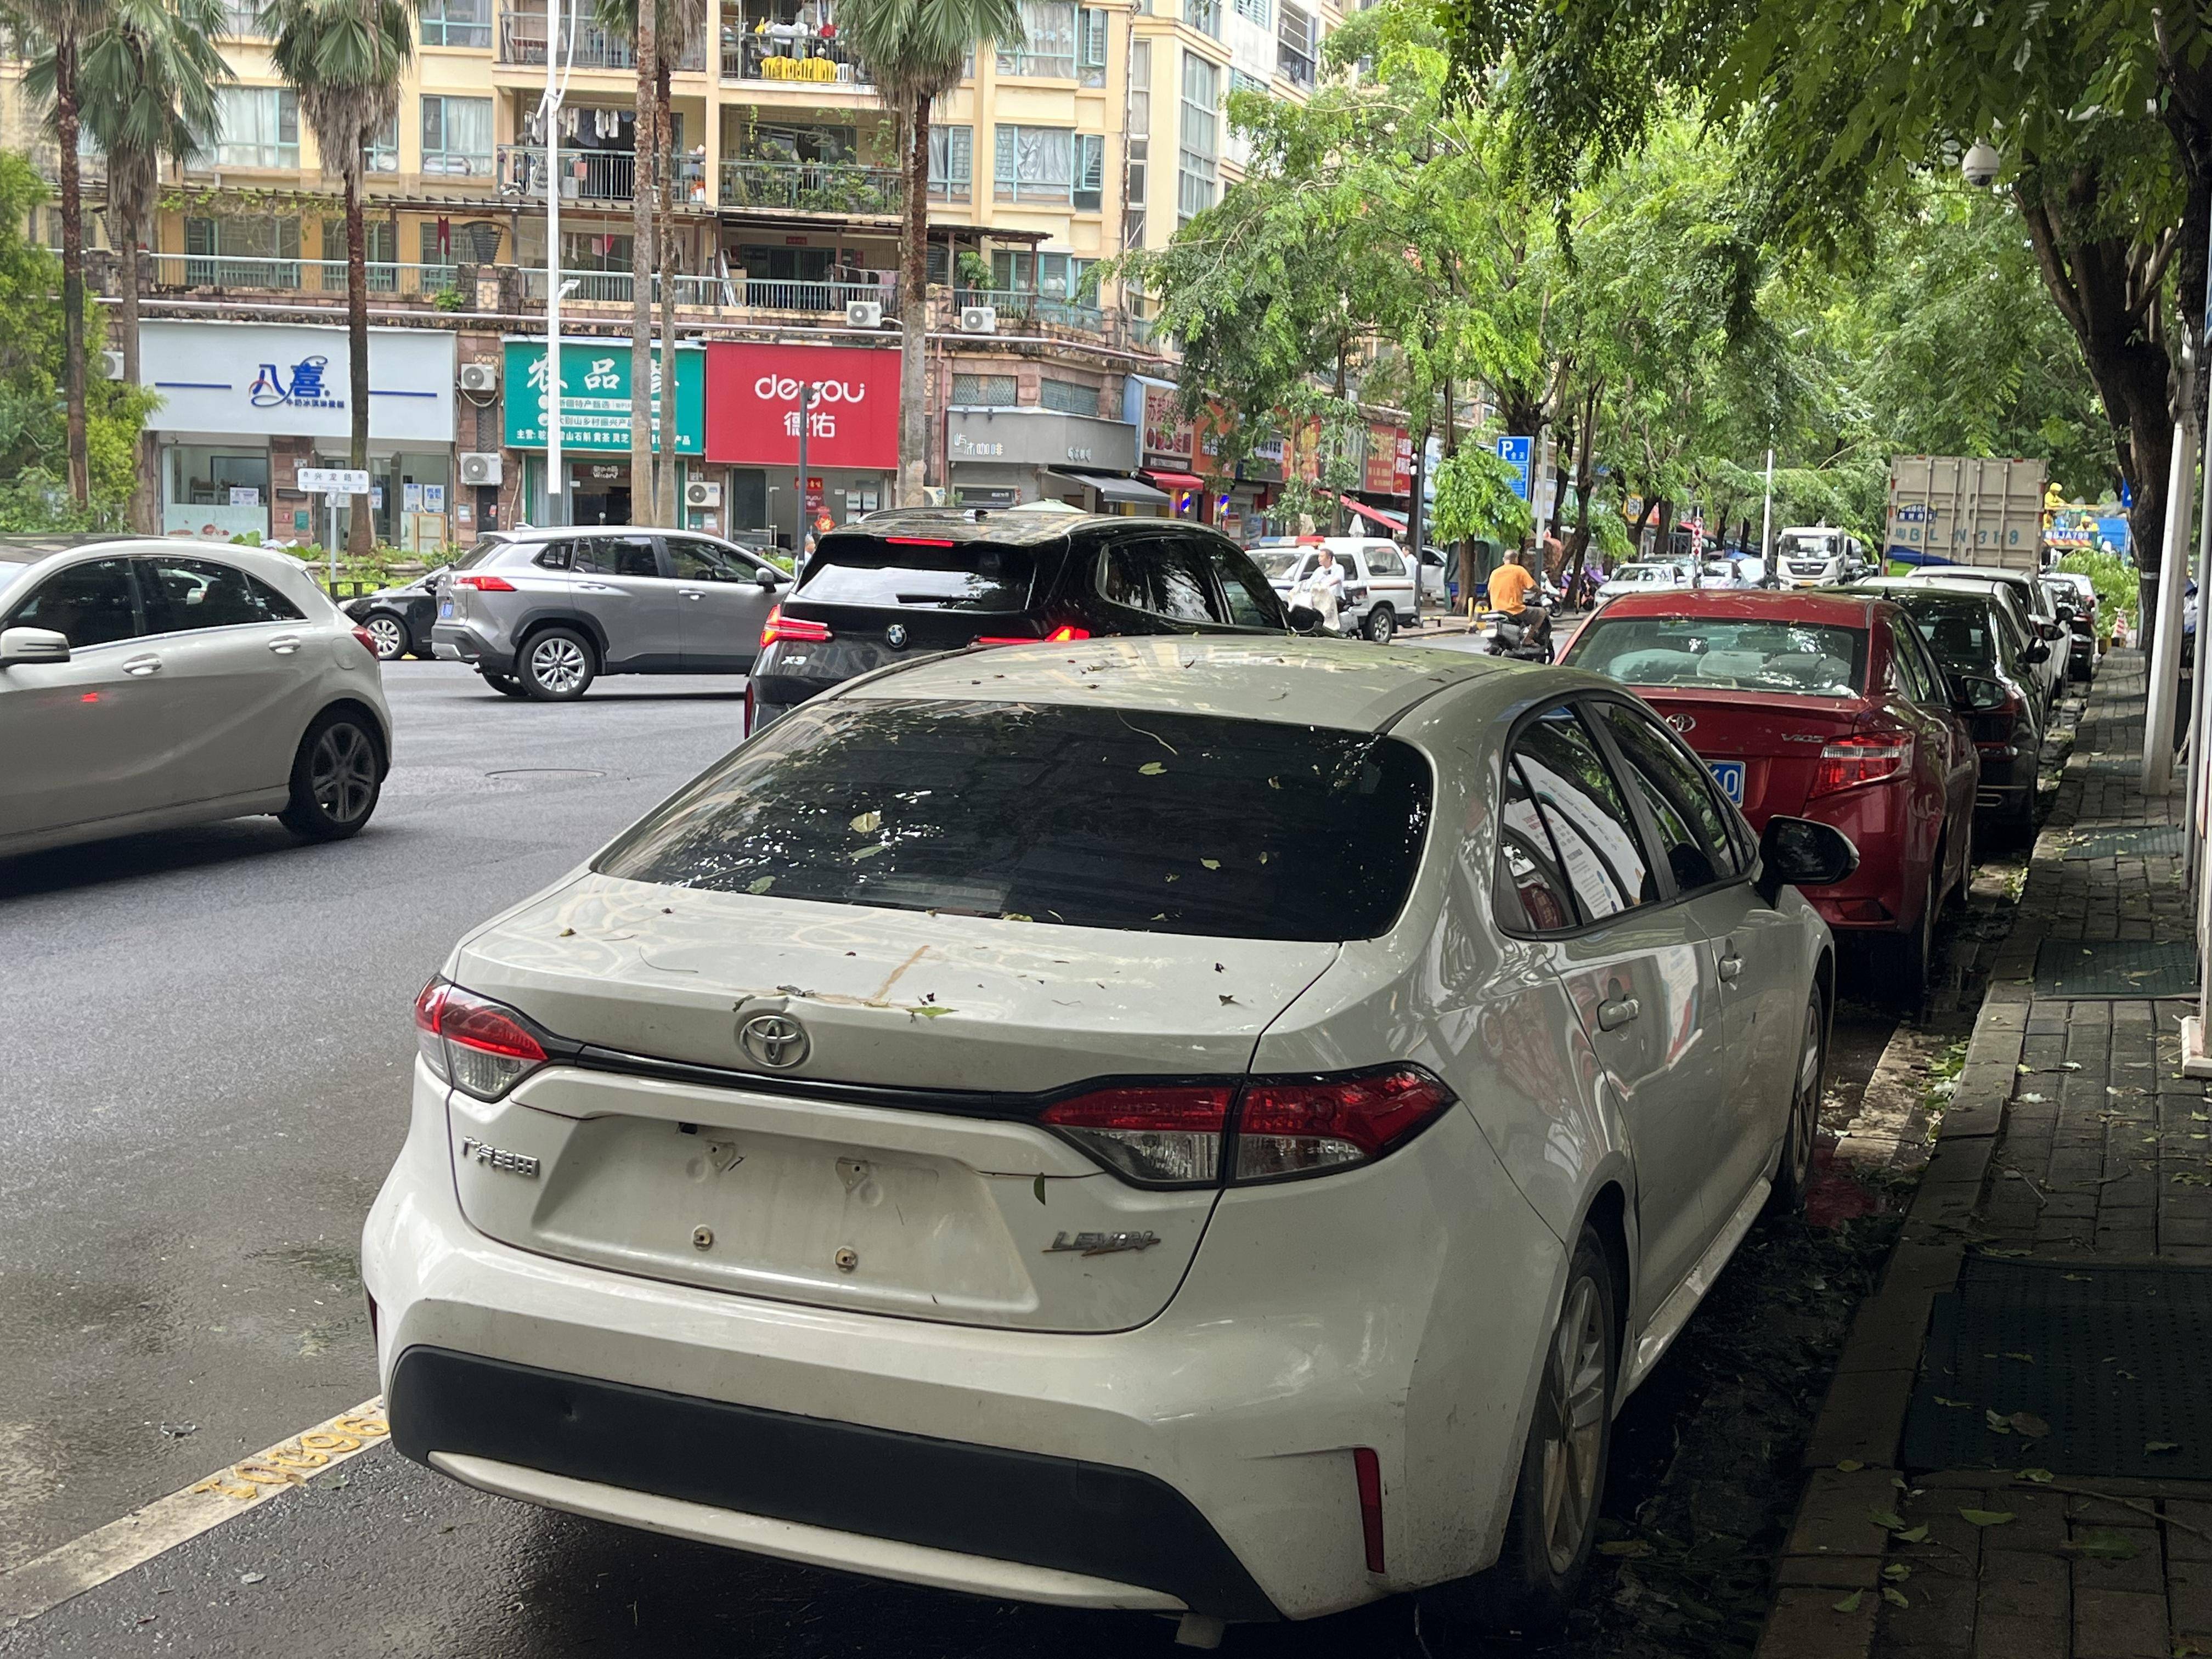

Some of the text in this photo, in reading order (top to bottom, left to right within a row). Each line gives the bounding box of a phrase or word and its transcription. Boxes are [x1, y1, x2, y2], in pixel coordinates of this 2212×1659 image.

[783, 411, 836, 438] 德佑
[1501, 441, 1514, 460] P
[781, 656, 807, 665] X3
[1781, 733, 1825, 743] VIOS
[462, 1136, 540, 1177] 广汽丰田
